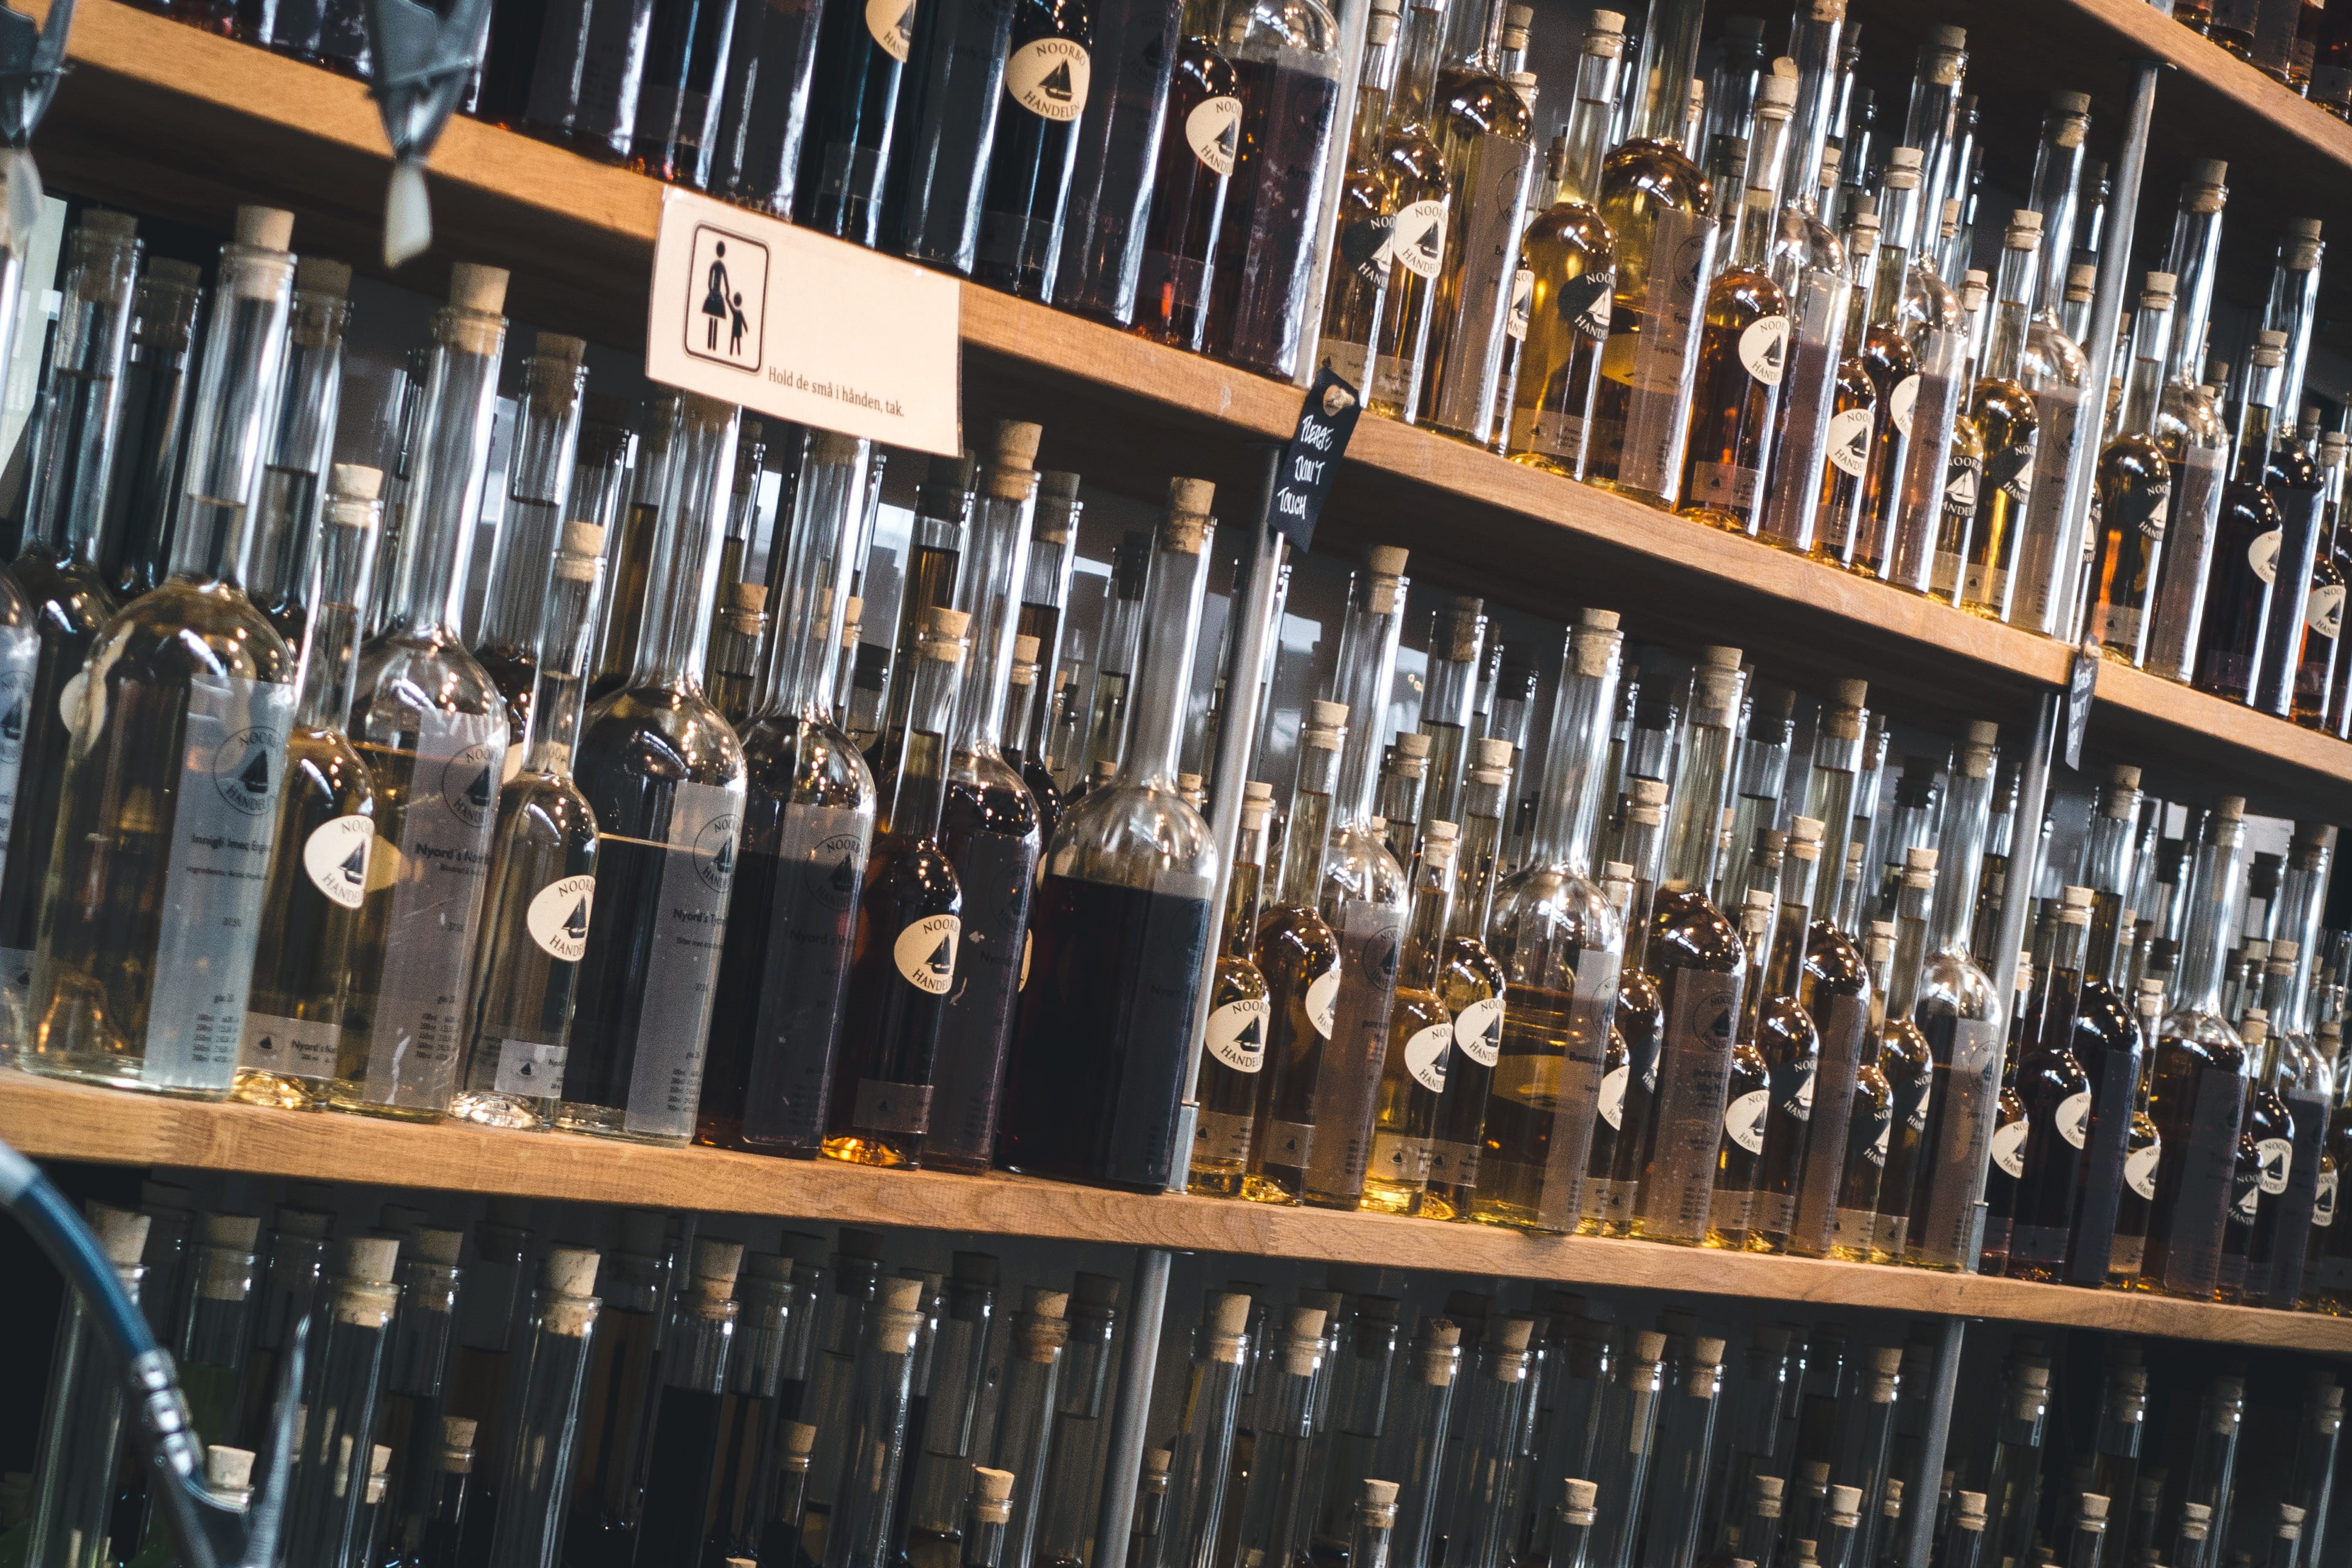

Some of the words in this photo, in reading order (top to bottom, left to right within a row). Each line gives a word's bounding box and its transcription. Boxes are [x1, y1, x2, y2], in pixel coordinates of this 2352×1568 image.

[1036, 42, 1086, 66] NOORBO
[1024, 90, 1080, 118] HANDELEN
[768, 366, 793, 387] Hold
[796, 374, 809, 391] de
[812, 381, 833, 398] små
[836, 385, 839, 399] i
[842, 386, 883, 413] hånden,
[885, 399, 904, 417] tak.
[1300, 414, 1334, 451] PLEASE
[1277, 486, 1307, 520] TOUCH
